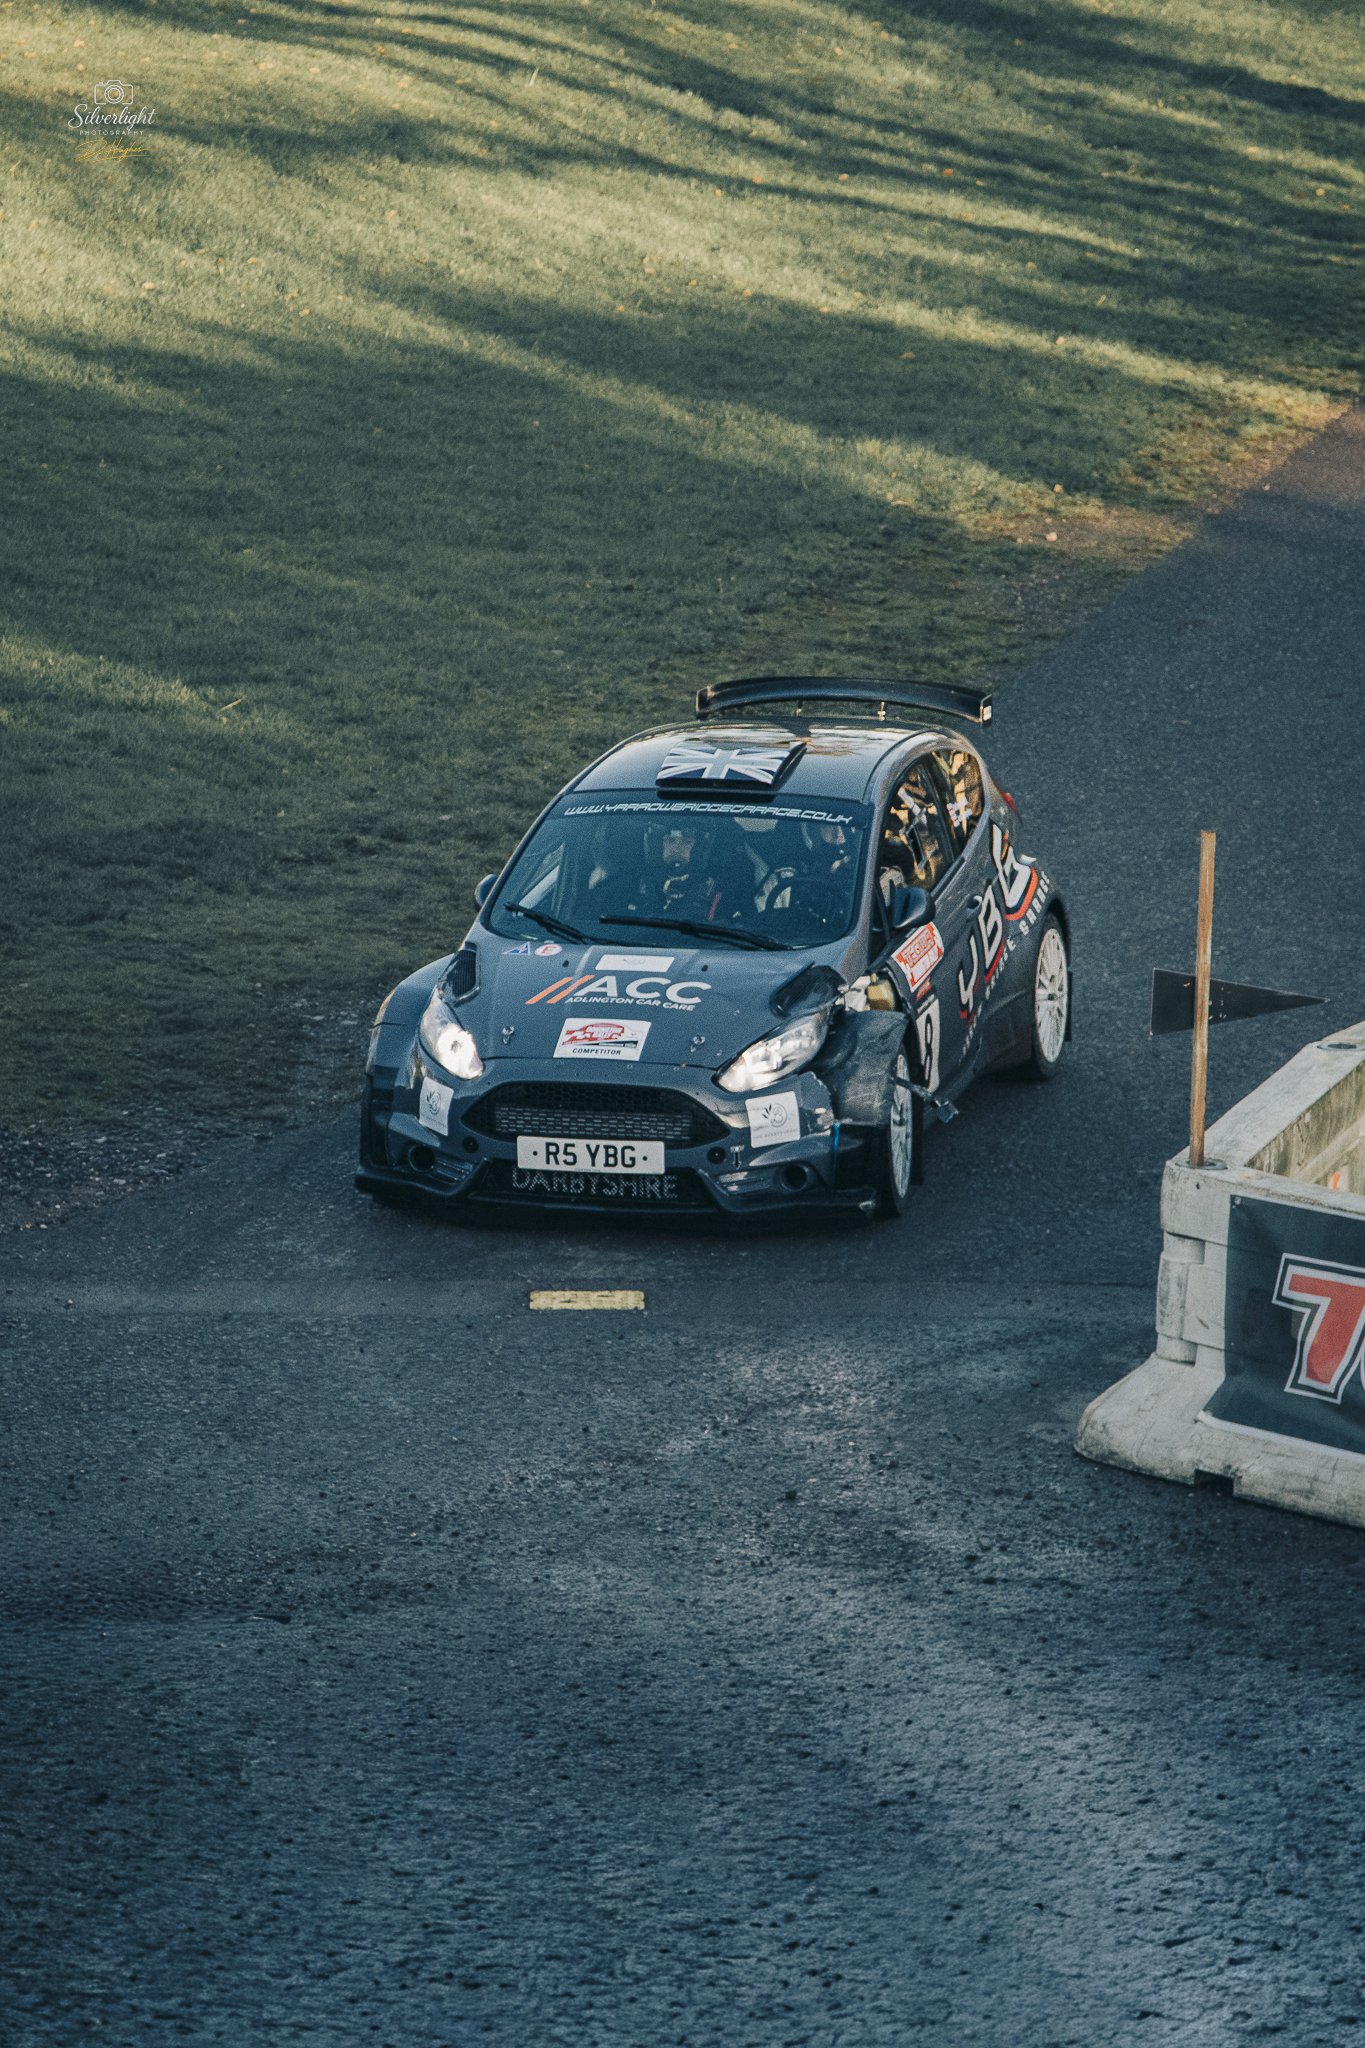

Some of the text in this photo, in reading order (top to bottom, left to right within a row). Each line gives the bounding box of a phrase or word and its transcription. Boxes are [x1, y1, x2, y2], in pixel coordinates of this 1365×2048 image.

[573, 975, 712, 1004] ACC
[564, 996, 696, 1012] ADLINGTON CAR CARE
[572, 1047, 622, 1056] COMPETITOR
[544, 1141, 636, 1168] R5 YBG
